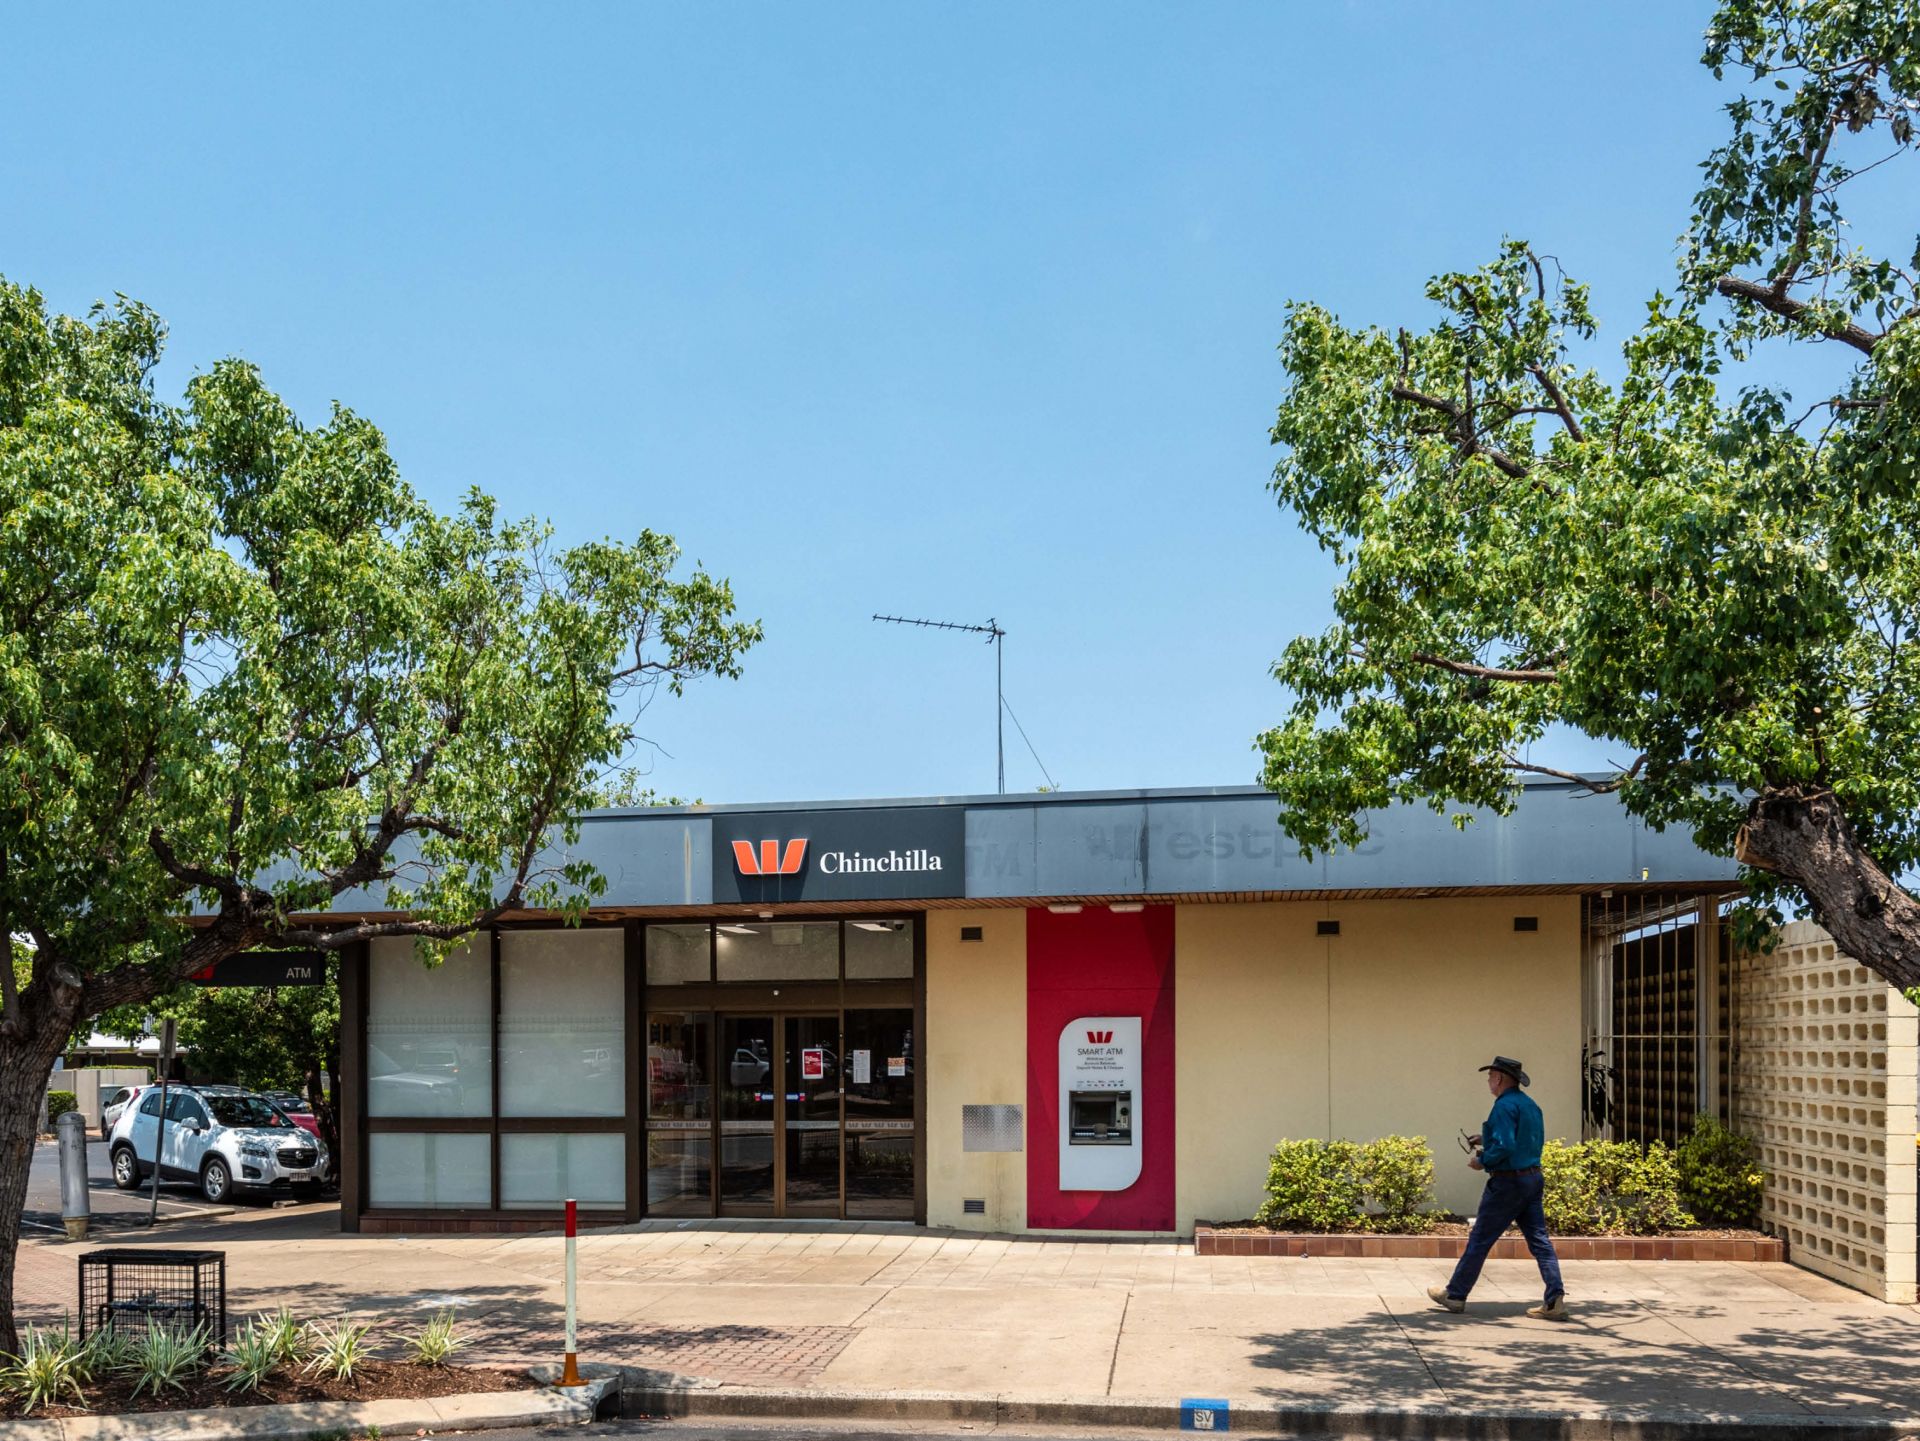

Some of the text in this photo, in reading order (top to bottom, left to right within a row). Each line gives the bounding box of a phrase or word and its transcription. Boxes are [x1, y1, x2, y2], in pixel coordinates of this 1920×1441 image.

[819, 849, 943, 874] Chinchilla
[286, 966, 312, 979] ATM
[1077, 1047, 1124, 1056] SMART ATM
[1195, 1411, 1213, 1423] SV
